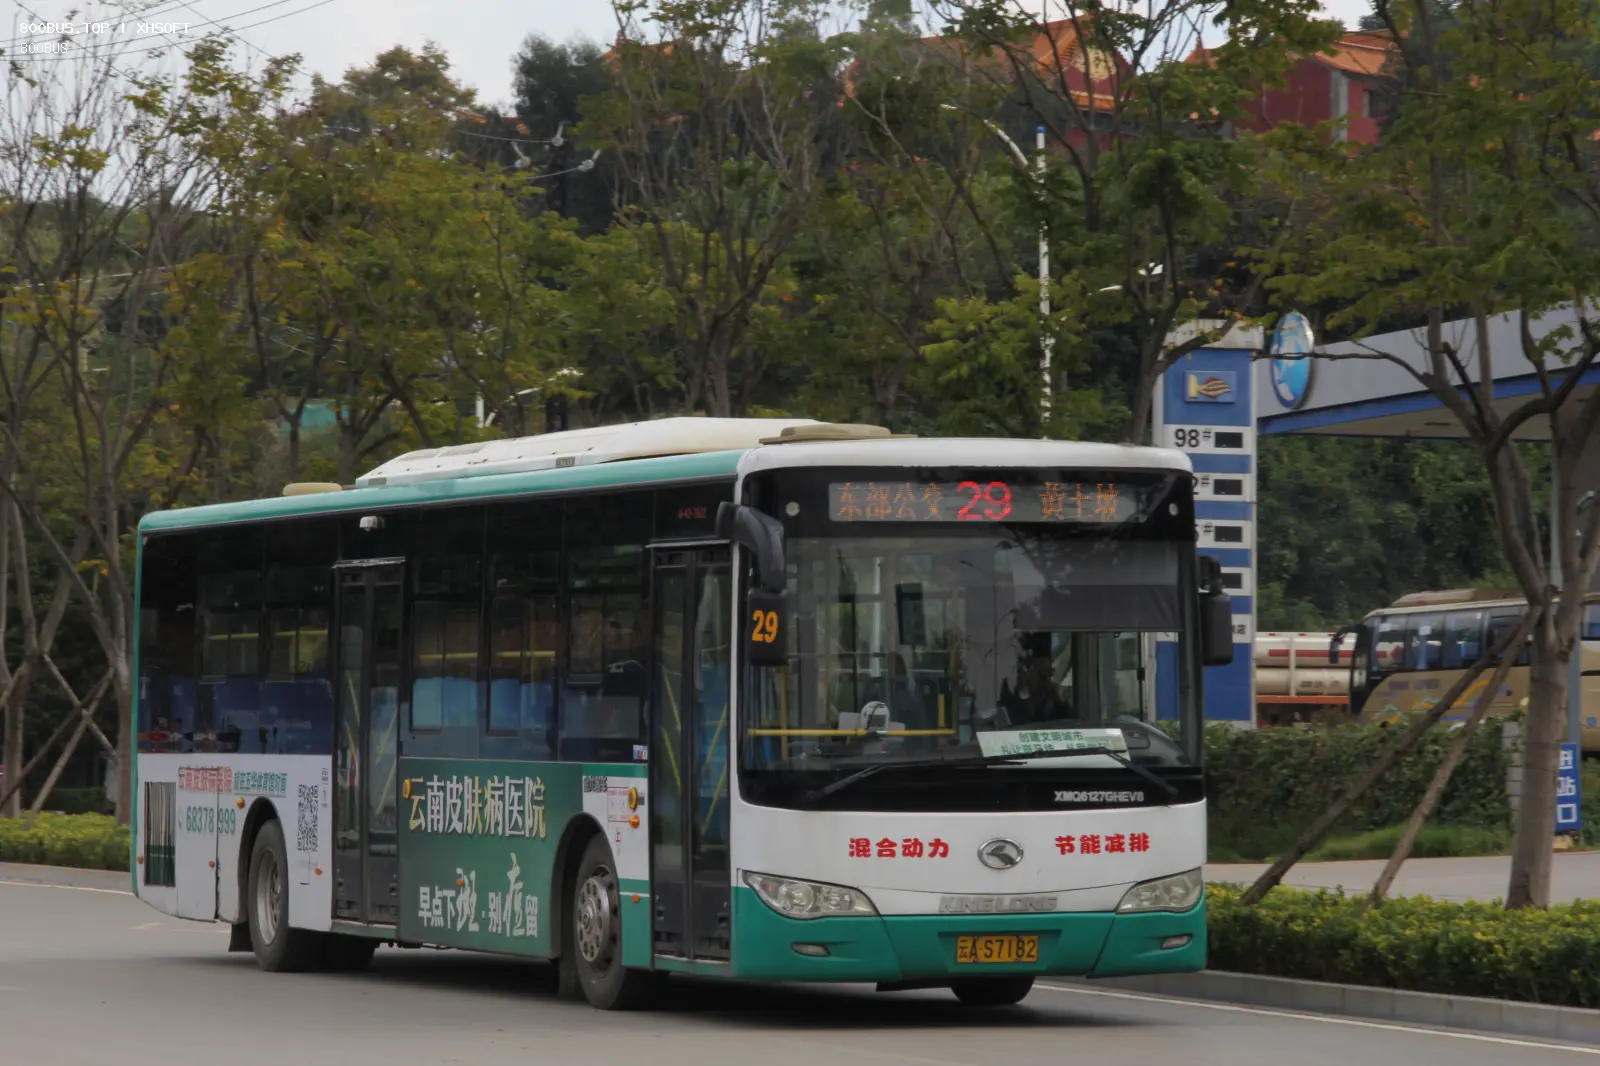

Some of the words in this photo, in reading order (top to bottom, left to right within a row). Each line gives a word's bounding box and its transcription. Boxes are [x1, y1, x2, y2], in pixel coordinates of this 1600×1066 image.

[955, 480, 1012, 521] 29
[751, 609, 779, 644] 29
[408, 774, 547, 839] 云南皮肤病医院
[848, 837, 950, 859] 混合动力
[1054, 832, 1151, 856] 节能减排
[939, 896, 994, 913] KING
[996, 896, 1058, 912] LONG
